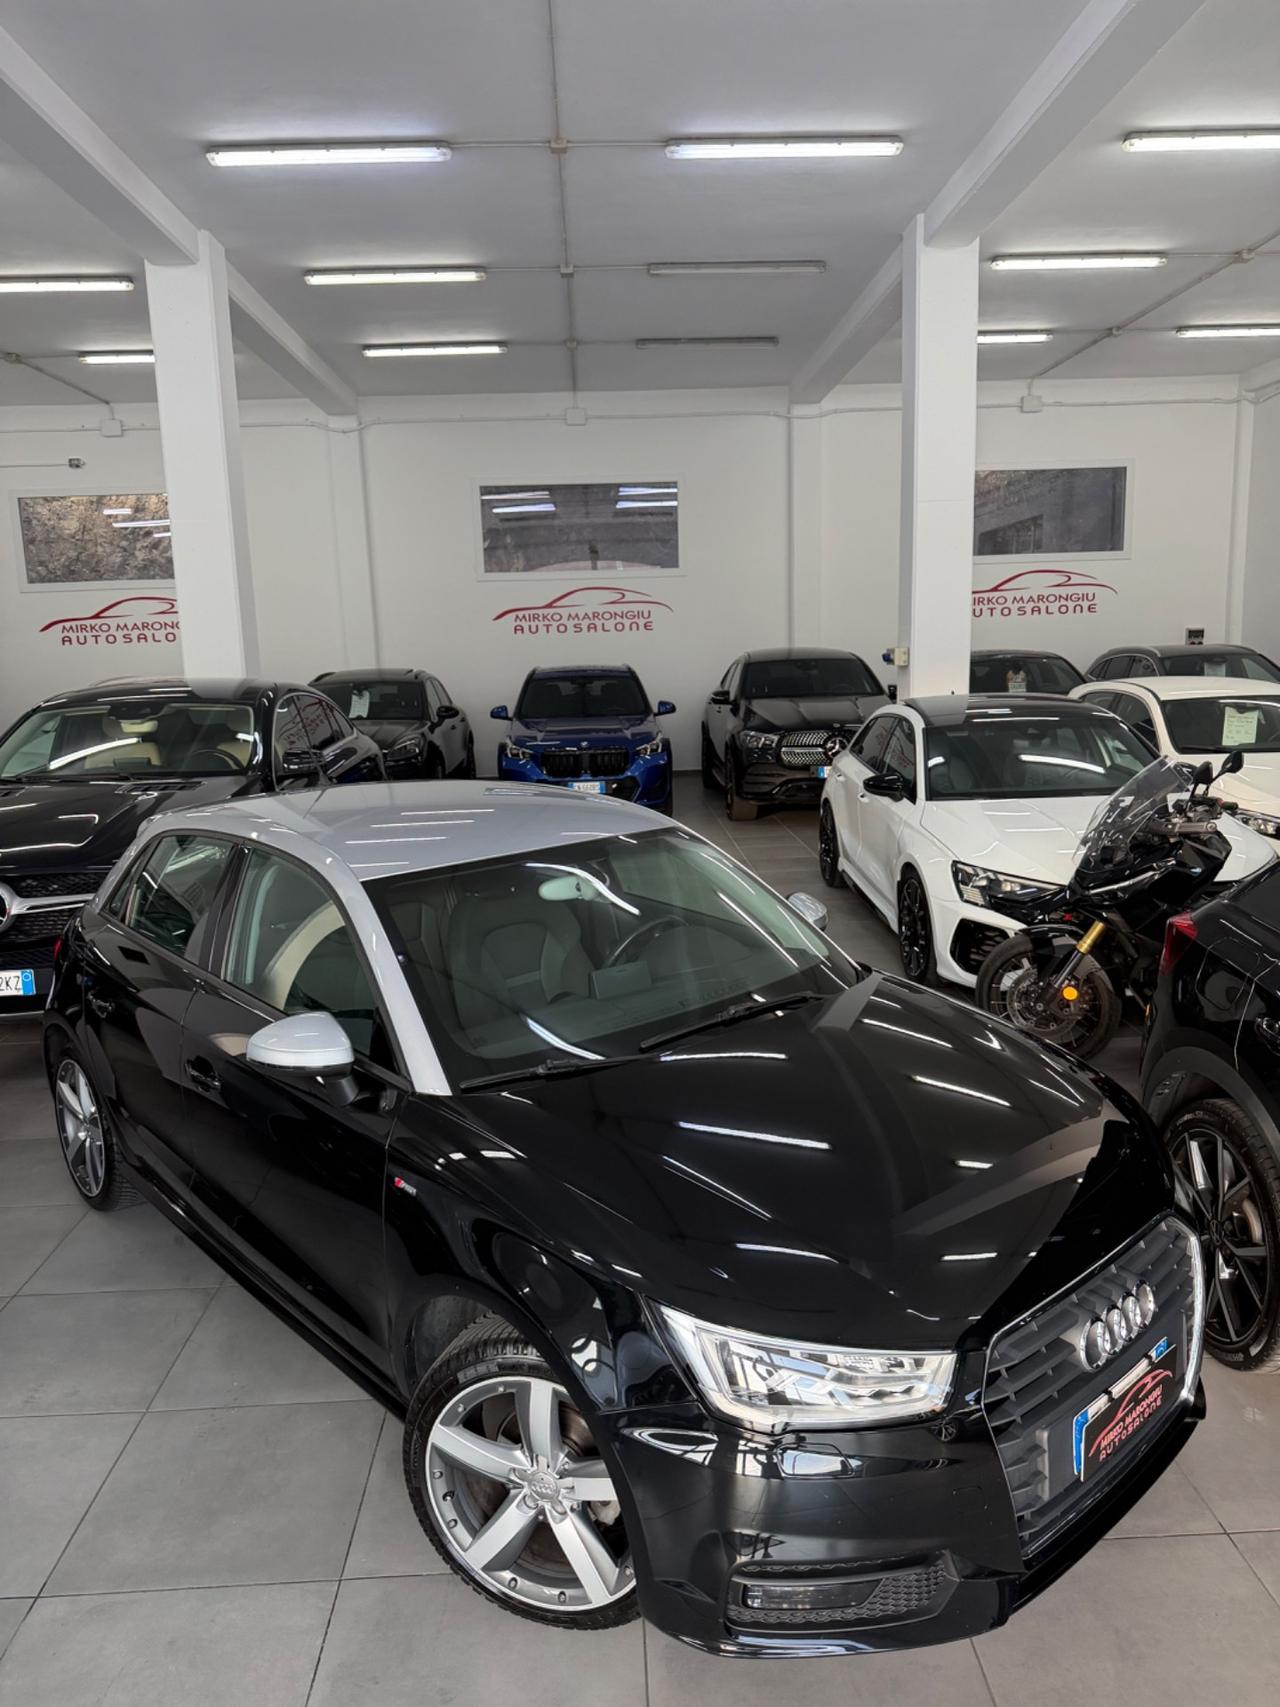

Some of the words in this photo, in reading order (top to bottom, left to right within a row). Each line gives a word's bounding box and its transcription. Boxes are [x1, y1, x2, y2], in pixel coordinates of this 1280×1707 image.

[973, 596, 1007, 606] IRKO
[1012, 592, 1096, 604] MARONGIU
[515, 612, 563, 622] MIRKO
[567, 610, 651, 621] MARONGIU
[972, 604, 1097, 617] UTOSALONE
[61, 623, 111, 634] MIRKO
[116, 620, 180, 632] MARON
[513, 621, 653, 634] AUTOSALONE
[61, 633, 177, 645] AUTOSALO
[1100, 1420, 1125, 1450] MIRKO
[1124, 1384, 1163, 1428] MARONGIU
[1099, 1396, 1163, 1462] AUTOSALONE
